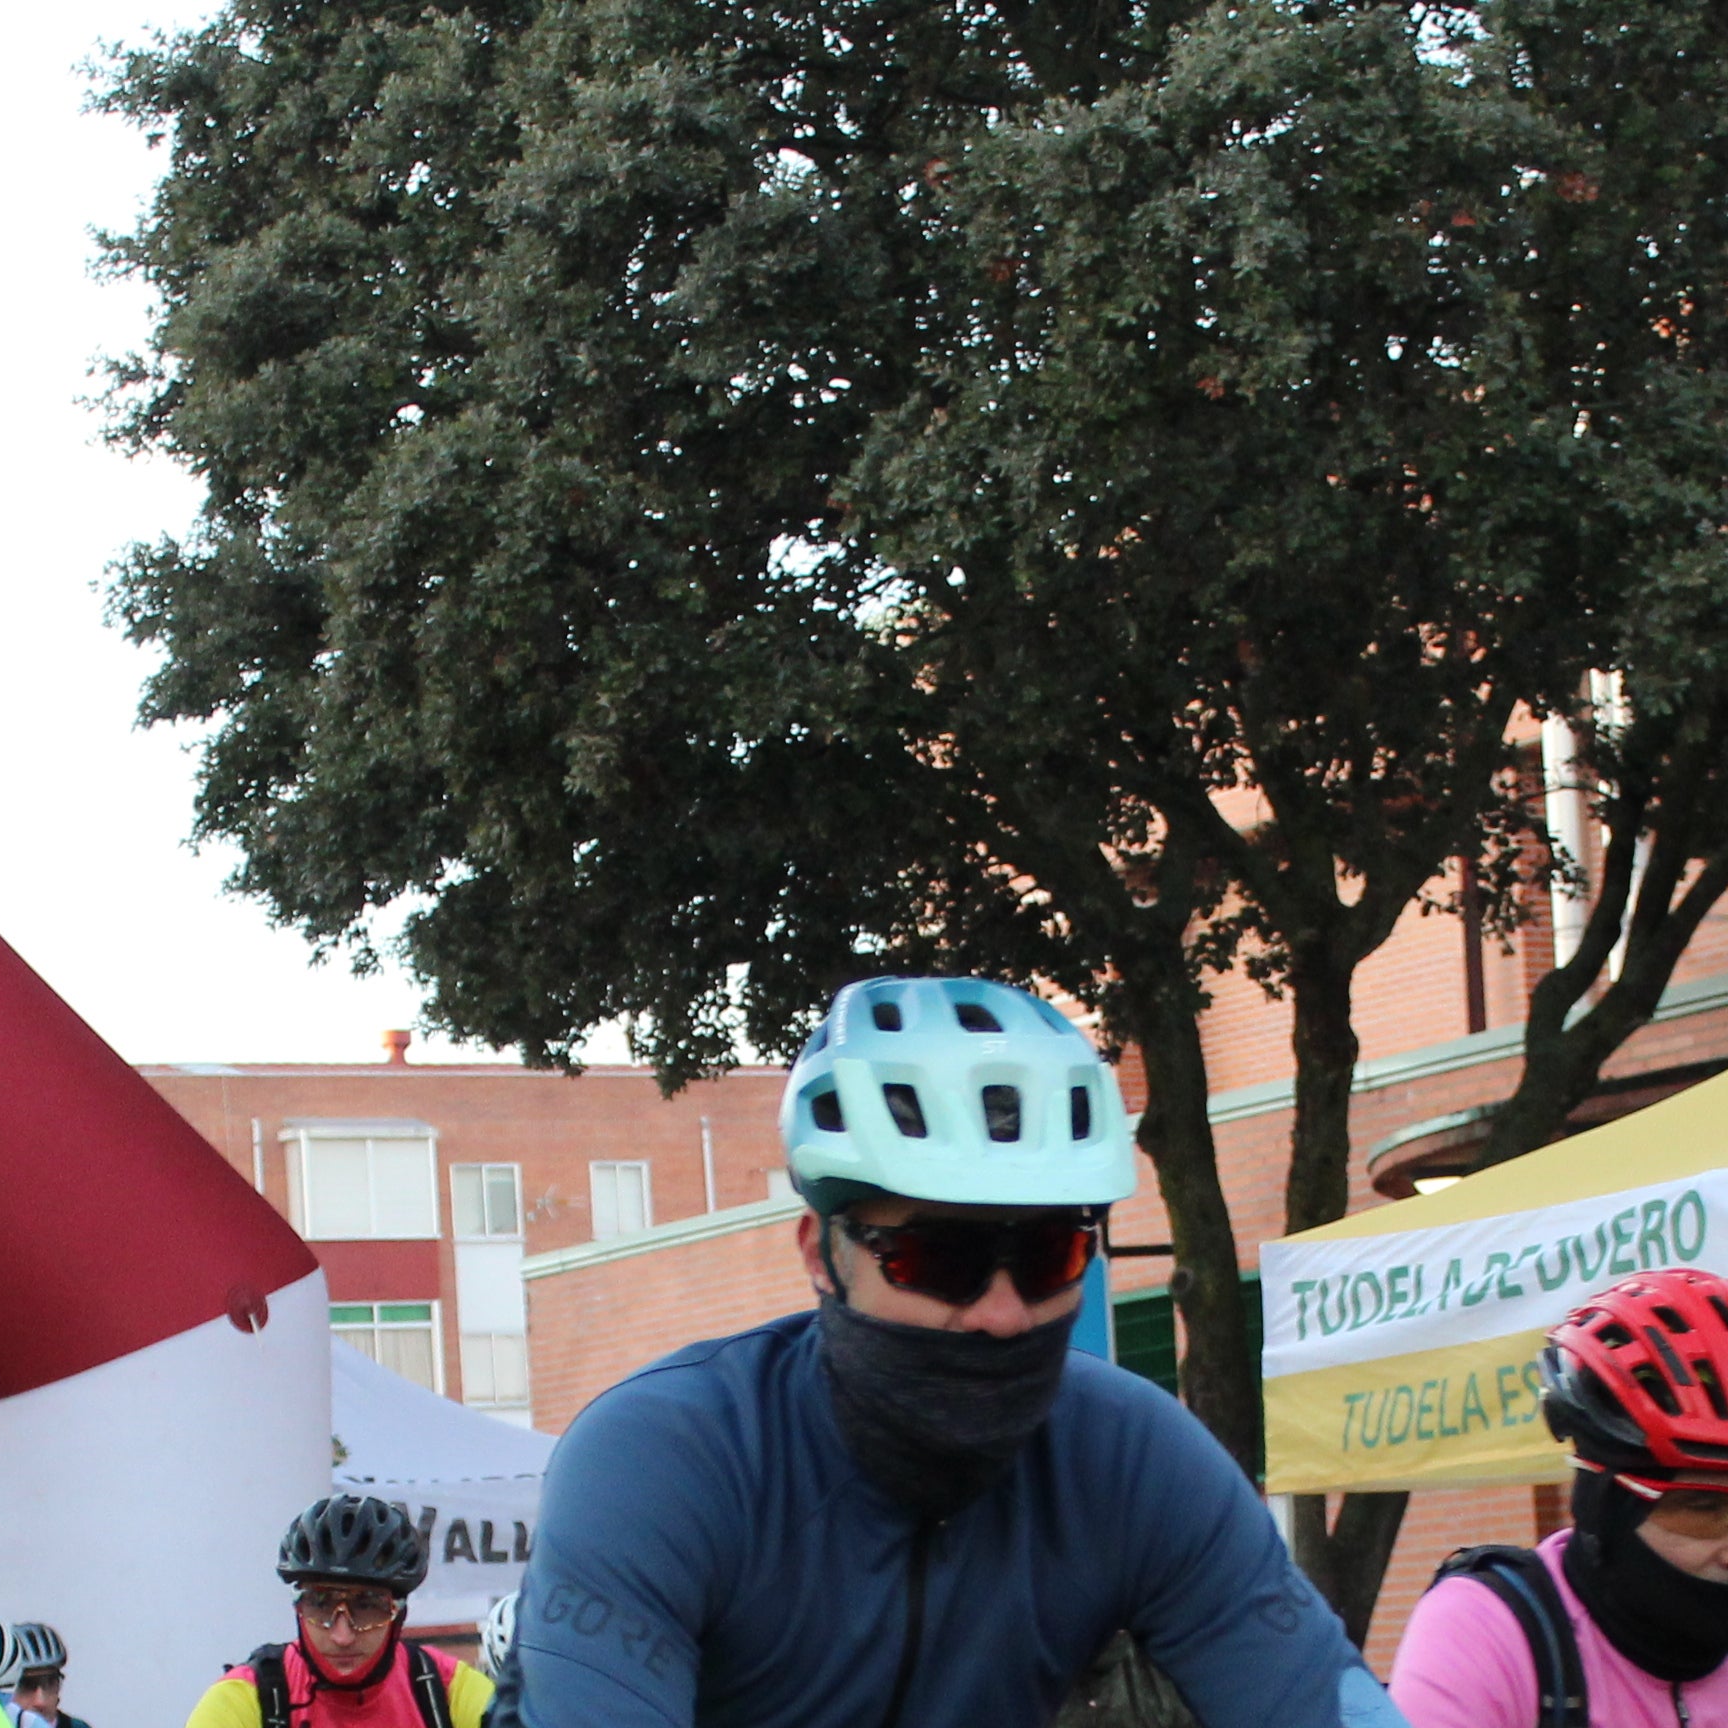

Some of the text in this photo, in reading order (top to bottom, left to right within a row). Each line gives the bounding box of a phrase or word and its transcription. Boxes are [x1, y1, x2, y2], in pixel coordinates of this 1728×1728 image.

[1291, 1258, 1462, 1342] TUDELA
[1534, 1188, 1708, 1293] DUERO
[1343, 1360, 1542, 1452] TUDELA ES
